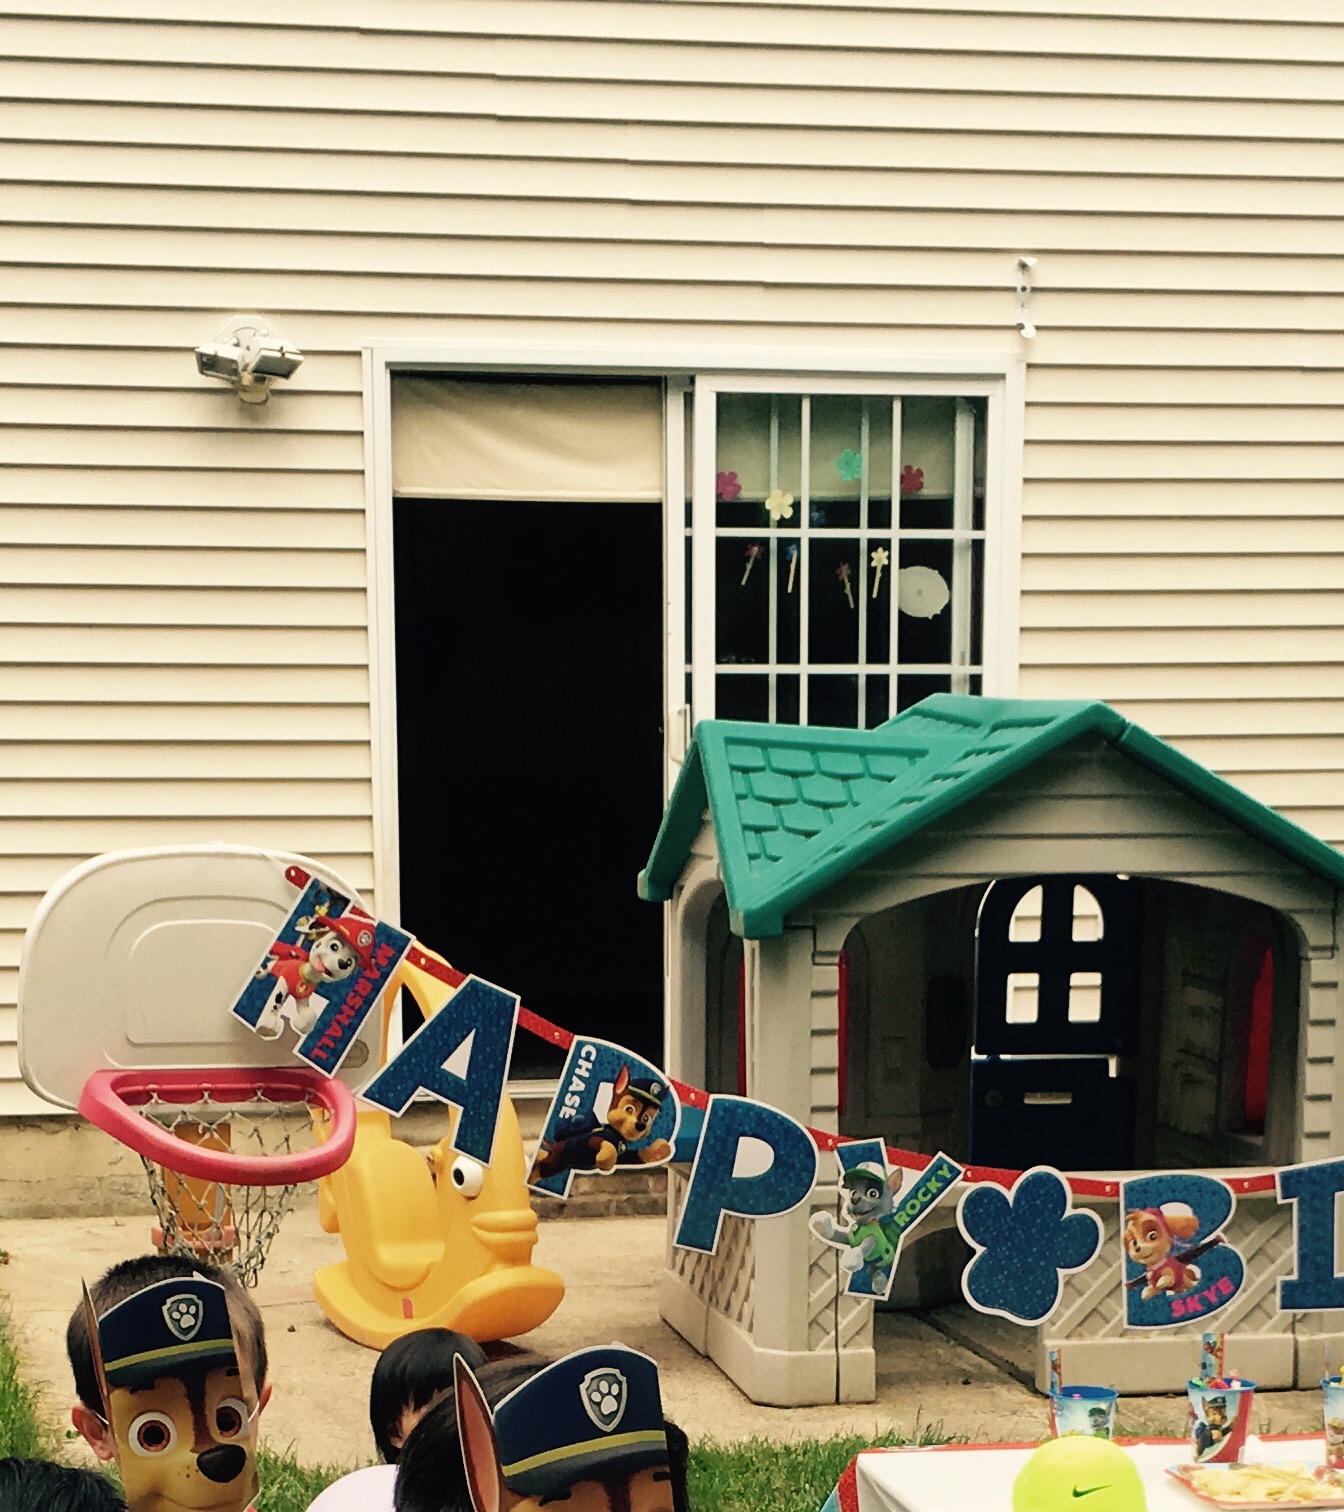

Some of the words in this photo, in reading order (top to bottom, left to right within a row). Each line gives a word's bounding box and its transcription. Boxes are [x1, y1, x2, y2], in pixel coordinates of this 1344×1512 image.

[310, 942, 395, 1060] MARSHALL
[232, 877, 963, 1298] HAPPY
[558, 1044, 597, 1120] CHASE
[893, 1163, 953, 1227] ROCKY
[1170, 1276, 1236, 1318] SKYE
